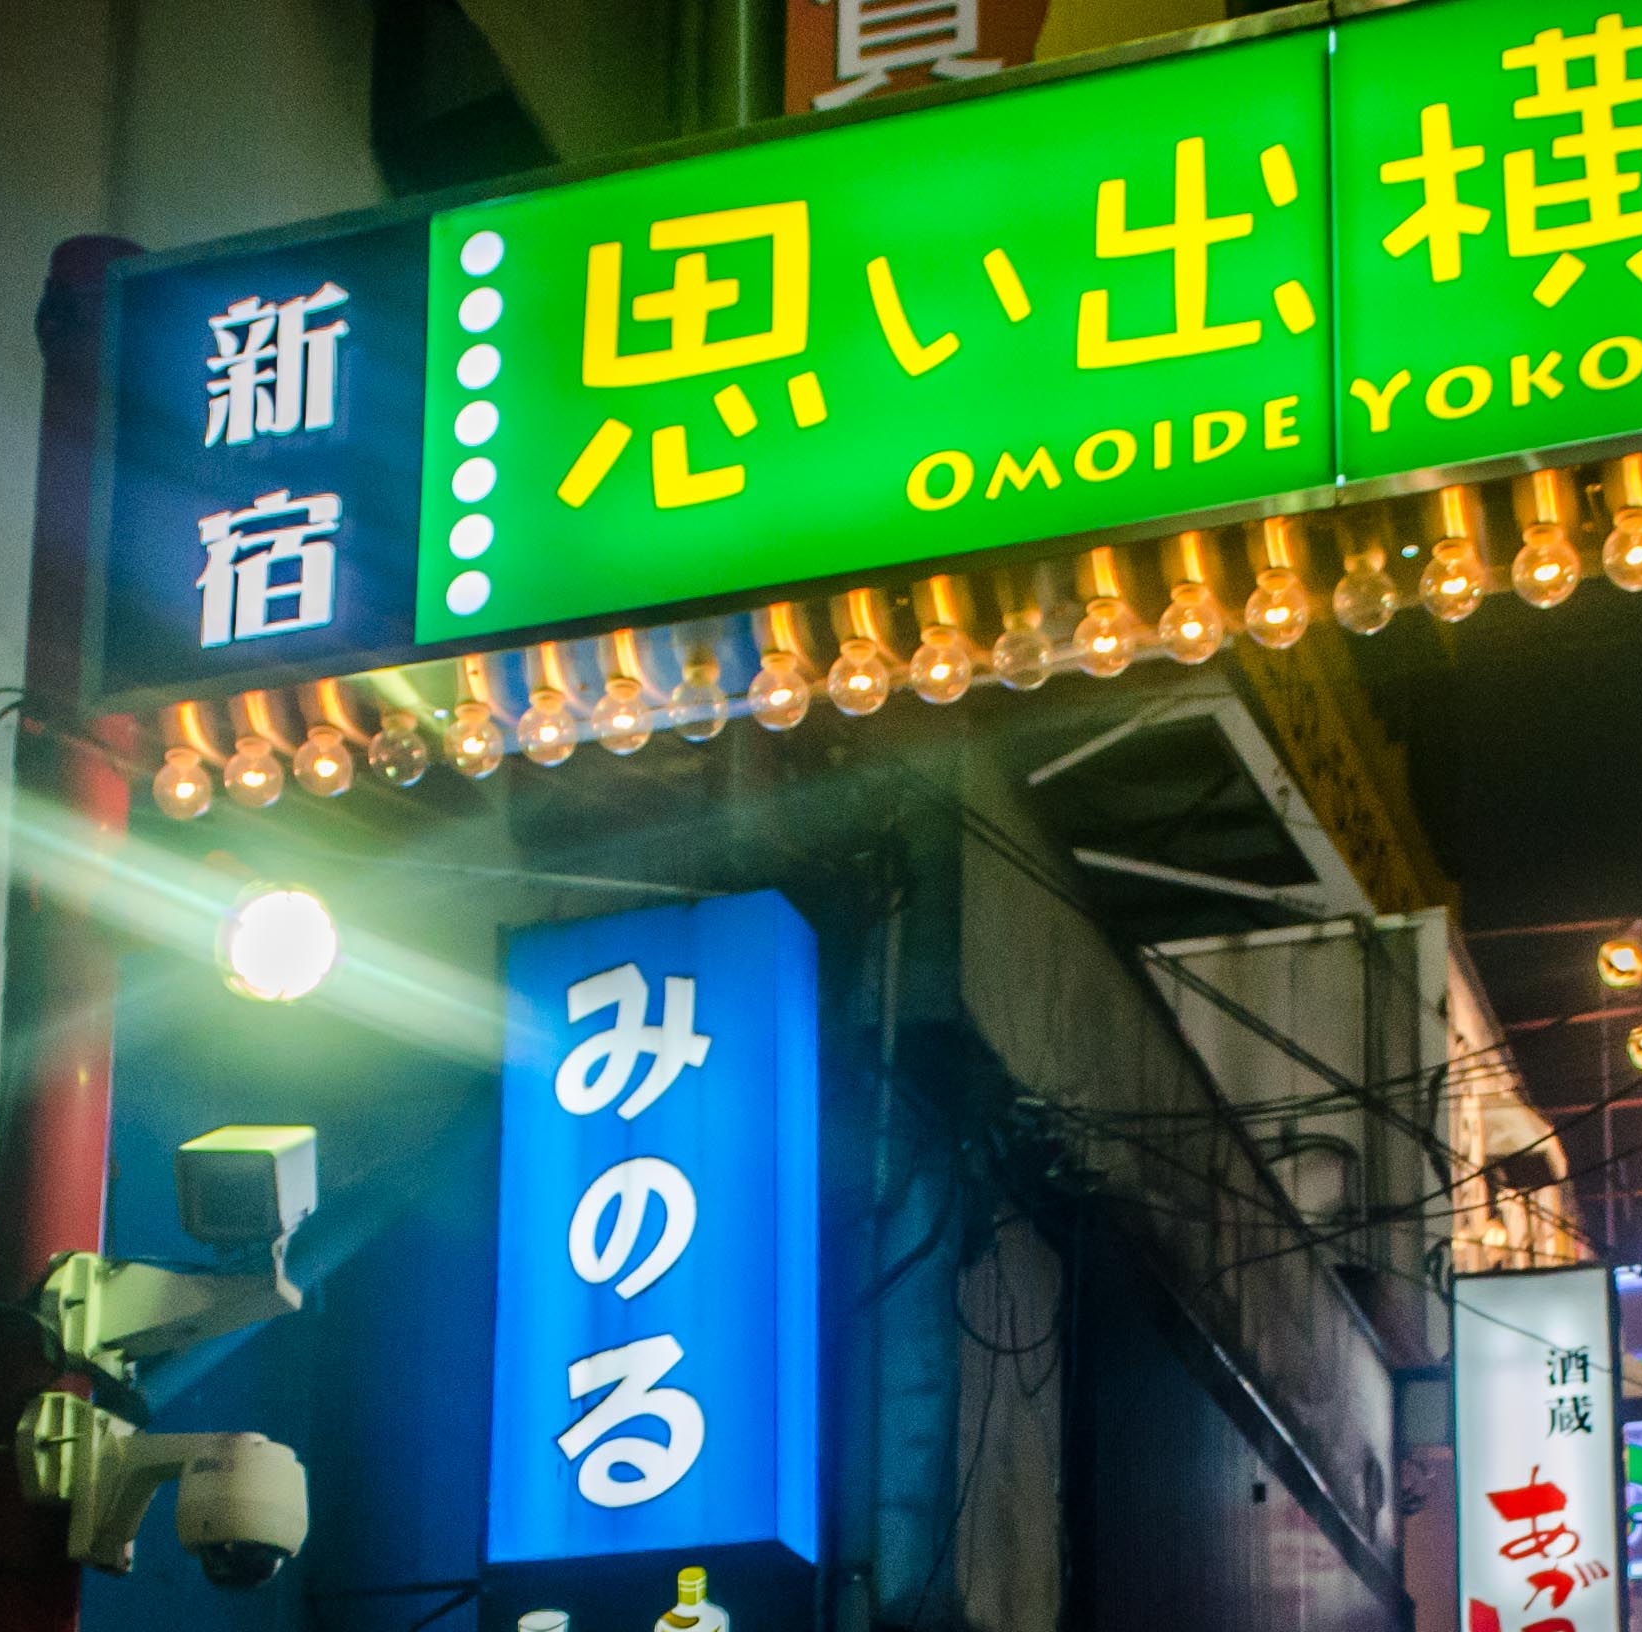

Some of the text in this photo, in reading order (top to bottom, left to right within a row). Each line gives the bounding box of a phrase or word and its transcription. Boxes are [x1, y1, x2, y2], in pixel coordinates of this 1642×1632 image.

[194, 280, 349, 649] 新宿
[904, 394, 1300, 513] OMOIDE
[553, 961, 711, 1508] みのる
[1546, 1346, 1593, 1437] 酒蔵
